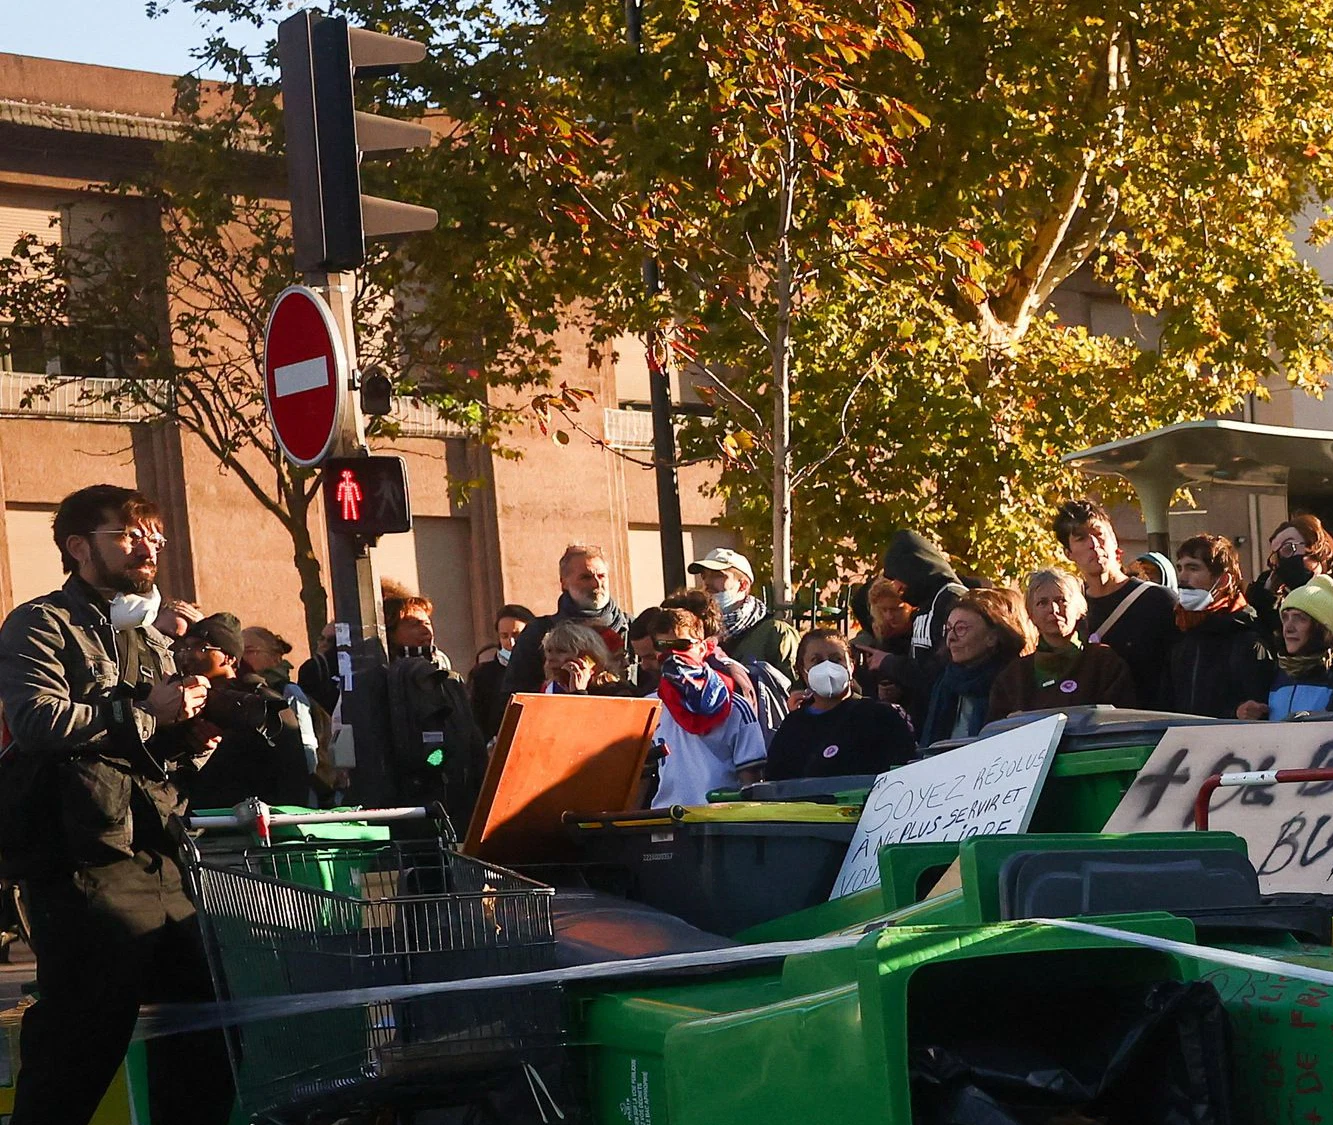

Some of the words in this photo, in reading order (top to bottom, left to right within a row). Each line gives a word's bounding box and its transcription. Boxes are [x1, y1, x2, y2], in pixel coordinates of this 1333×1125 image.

[866, 775, 966, 833] SOYEZ
[973, 748, 1047, 791] RÉSOLUS
[899, 815, 942, 843] PLUS
[942, 793, 999, 830] SERVIR
[1002, 786, 1028, 806] ET
[1138, 748, 1191, 819] +
[1295, 1053, 1324, 1094] DE
